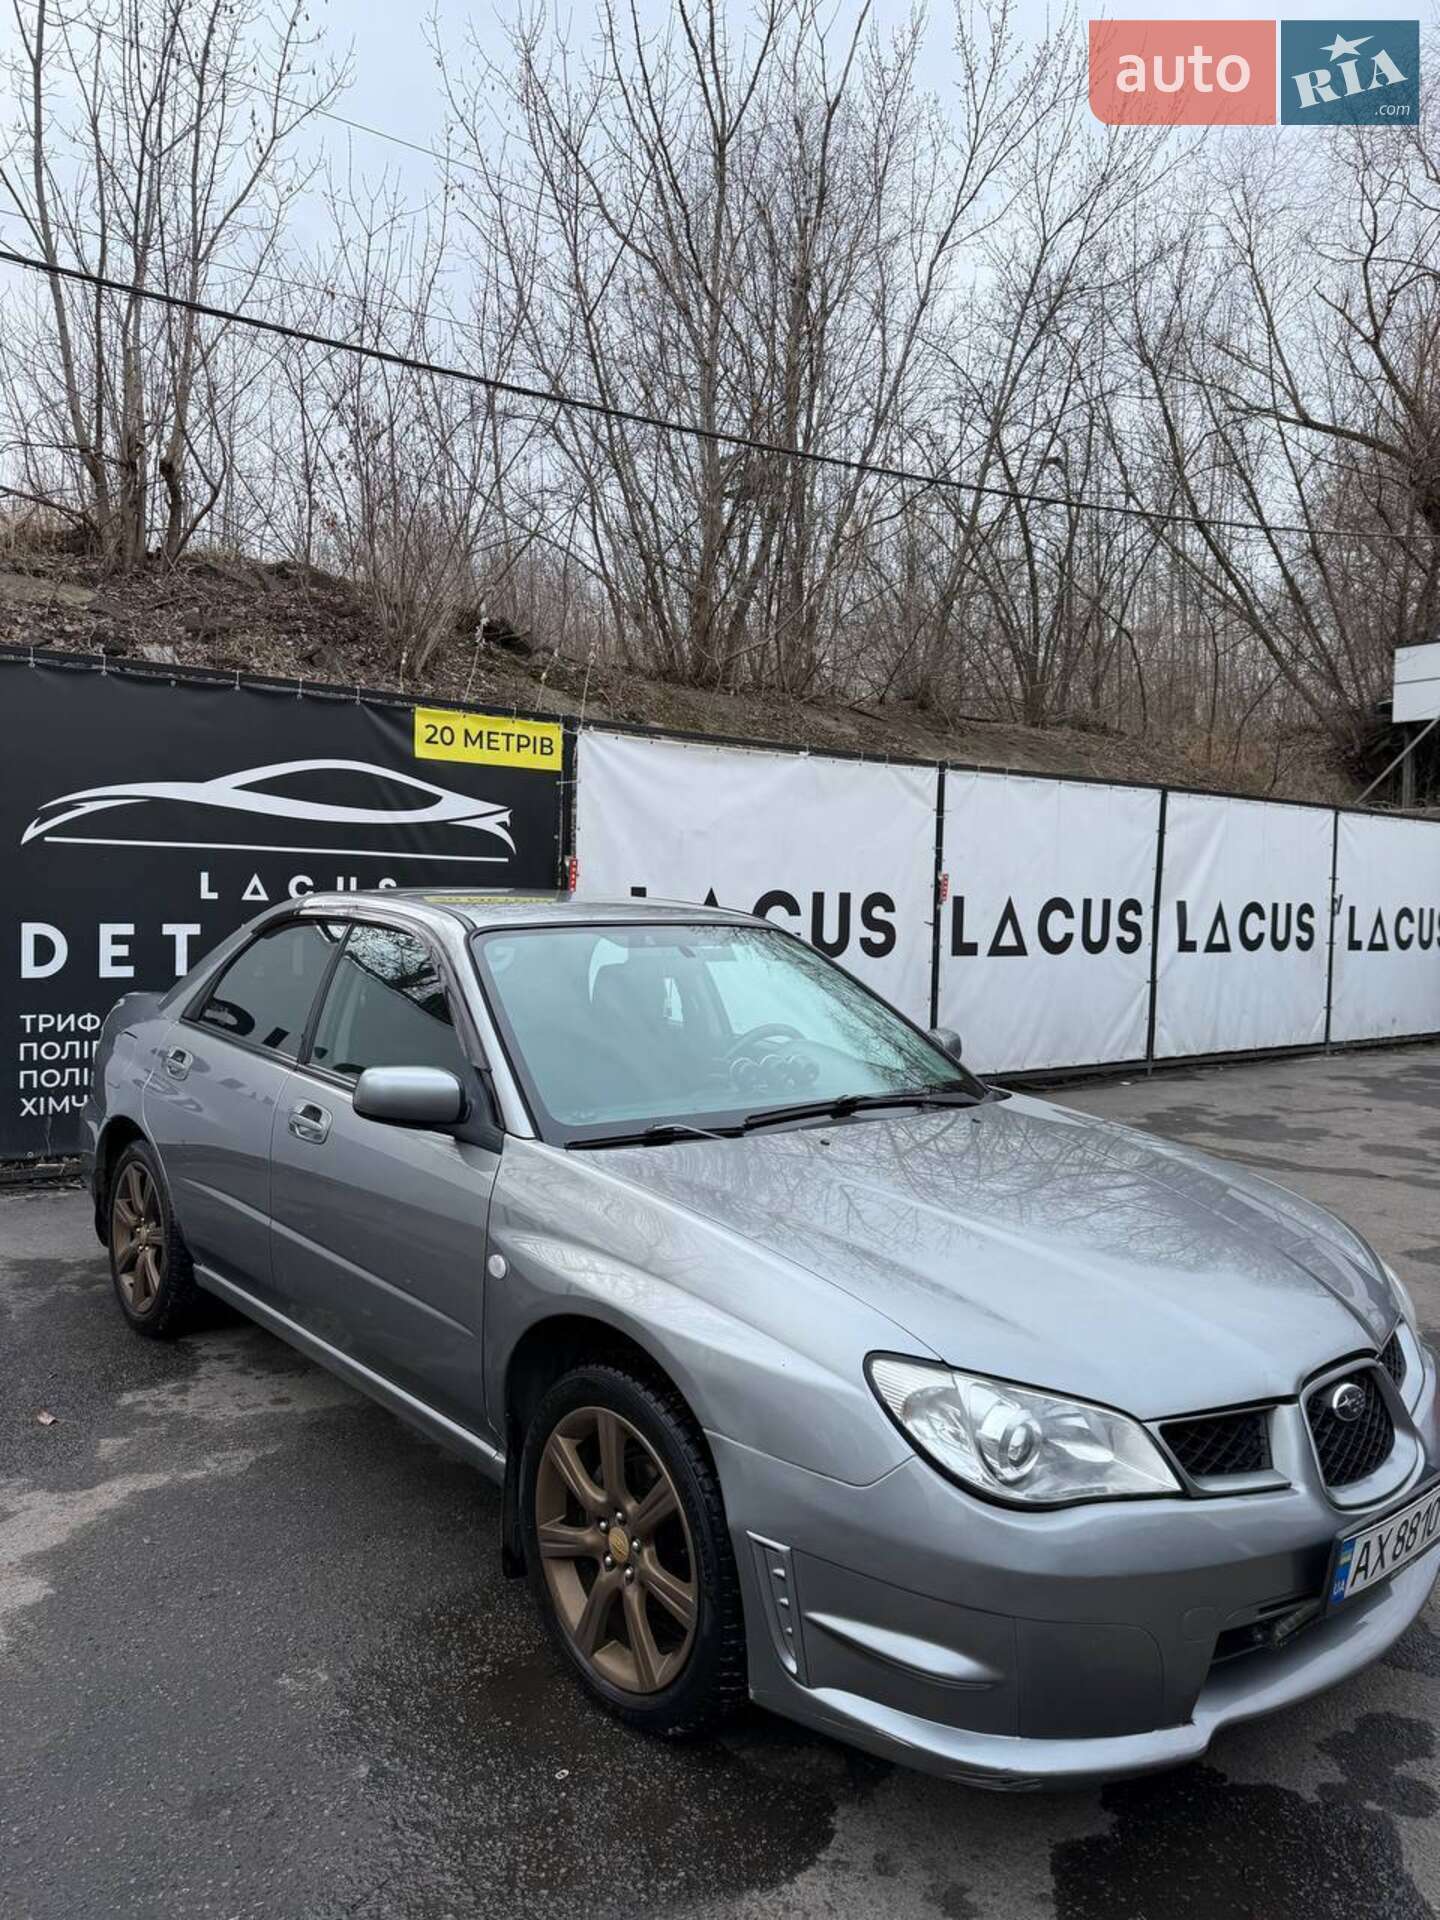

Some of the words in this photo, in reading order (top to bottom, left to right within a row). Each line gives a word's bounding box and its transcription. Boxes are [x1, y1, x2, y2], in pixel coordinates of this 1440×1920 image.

[424, 724, 455, 746] 20
[463, 729, 554, 756] МЕТРІВ
[21, 922, 201, 978] DET
[951, 896, 1143, 957] LACUS
[1176, 900, 1316, 953] LACUS
